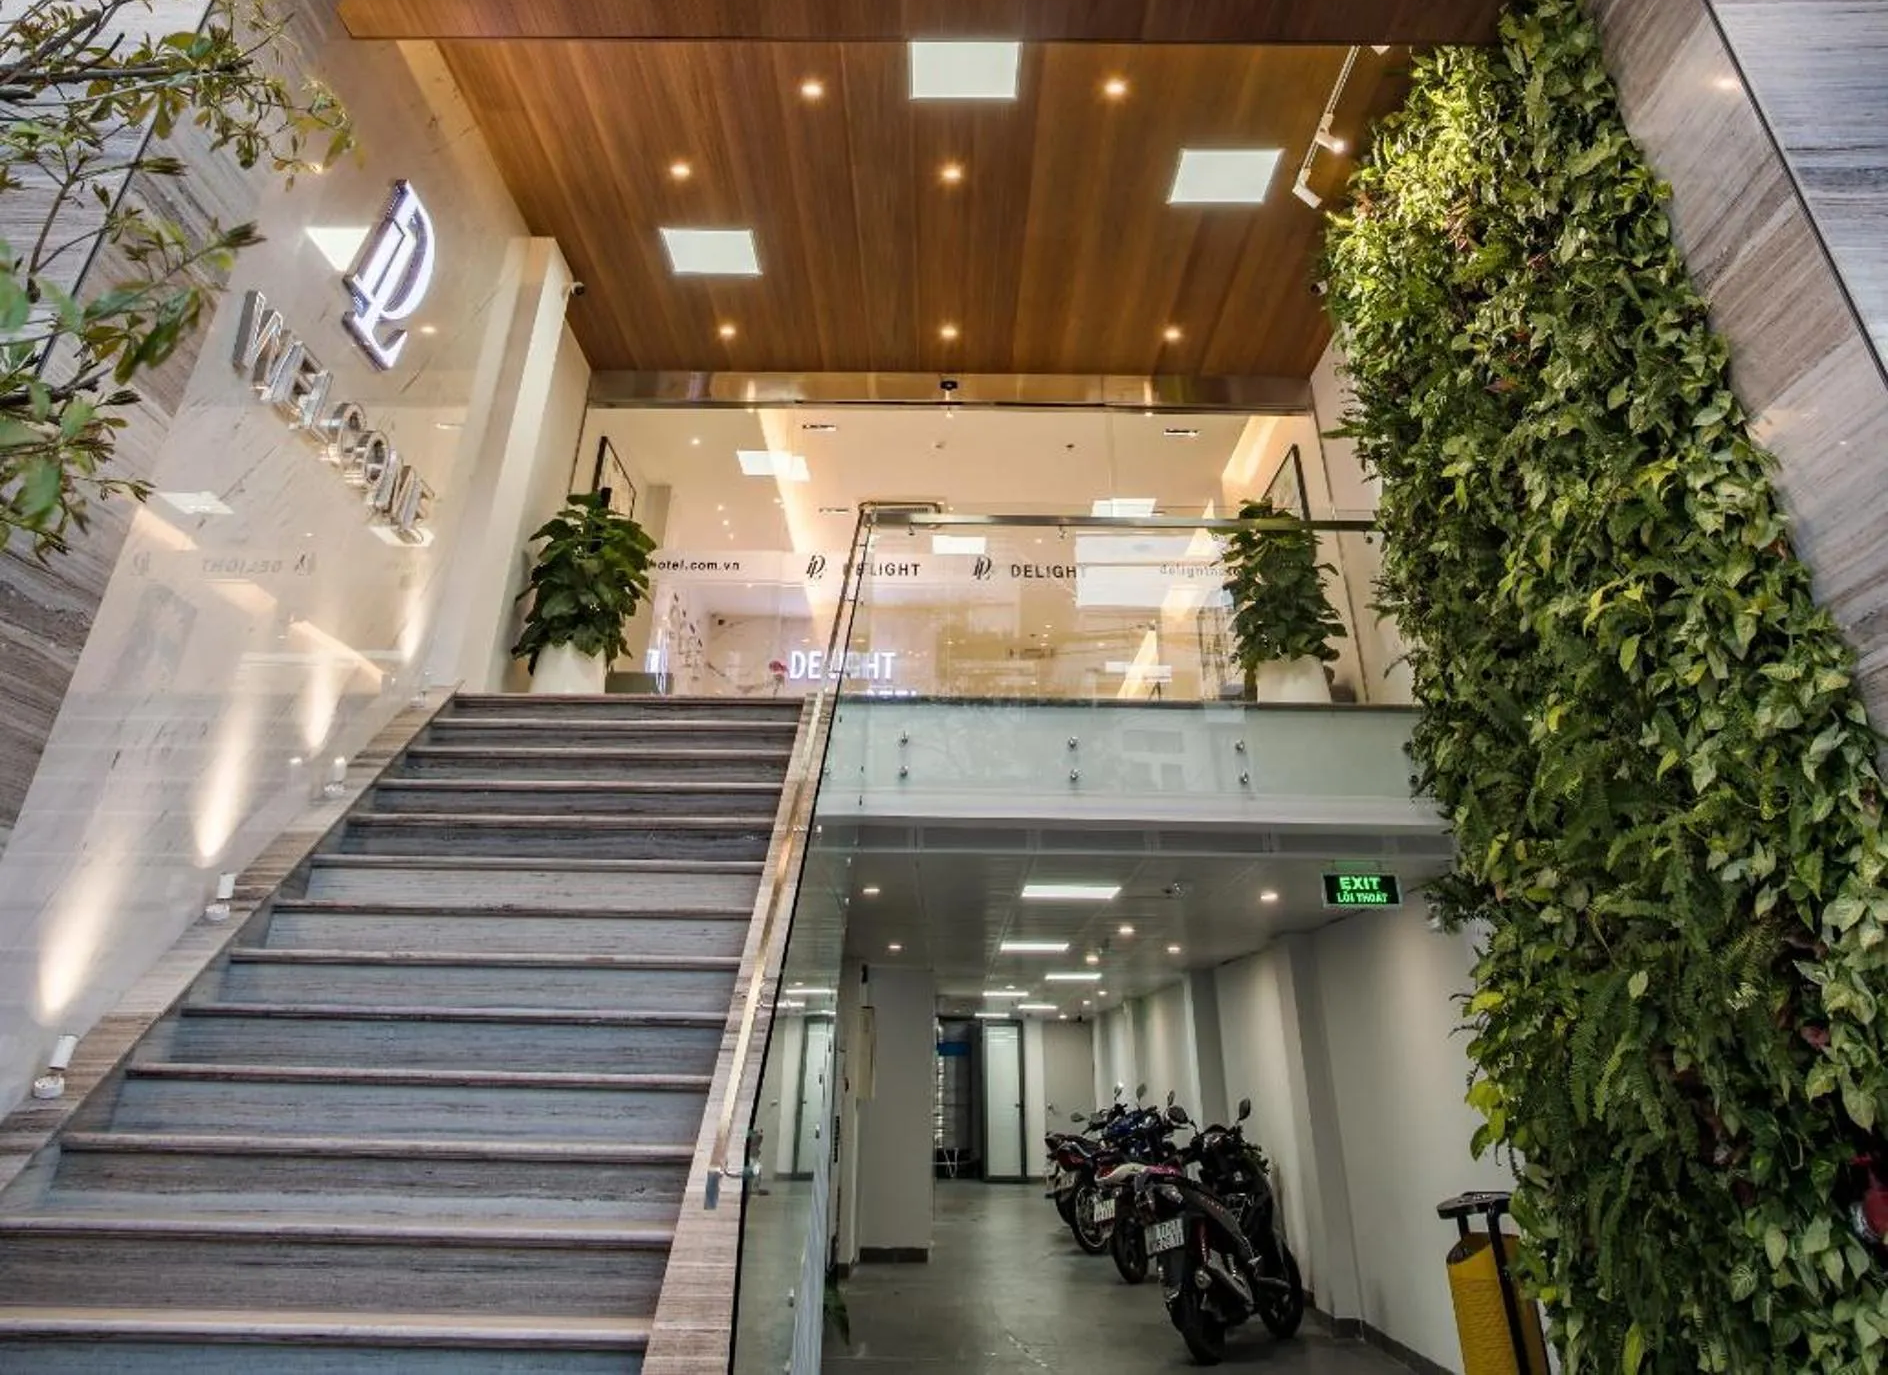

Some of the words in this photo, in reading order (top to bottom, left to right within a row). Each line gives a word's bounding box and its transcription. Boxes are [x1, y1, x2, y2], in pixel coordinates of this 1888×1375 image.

[647, 558, 741, 571] otel.com.vn
[843, 562, 921, 577] ELIGHT
[1010, 562, 1089, 579] DELIGHT
[1339, 876, 1381, 890] EXIT
